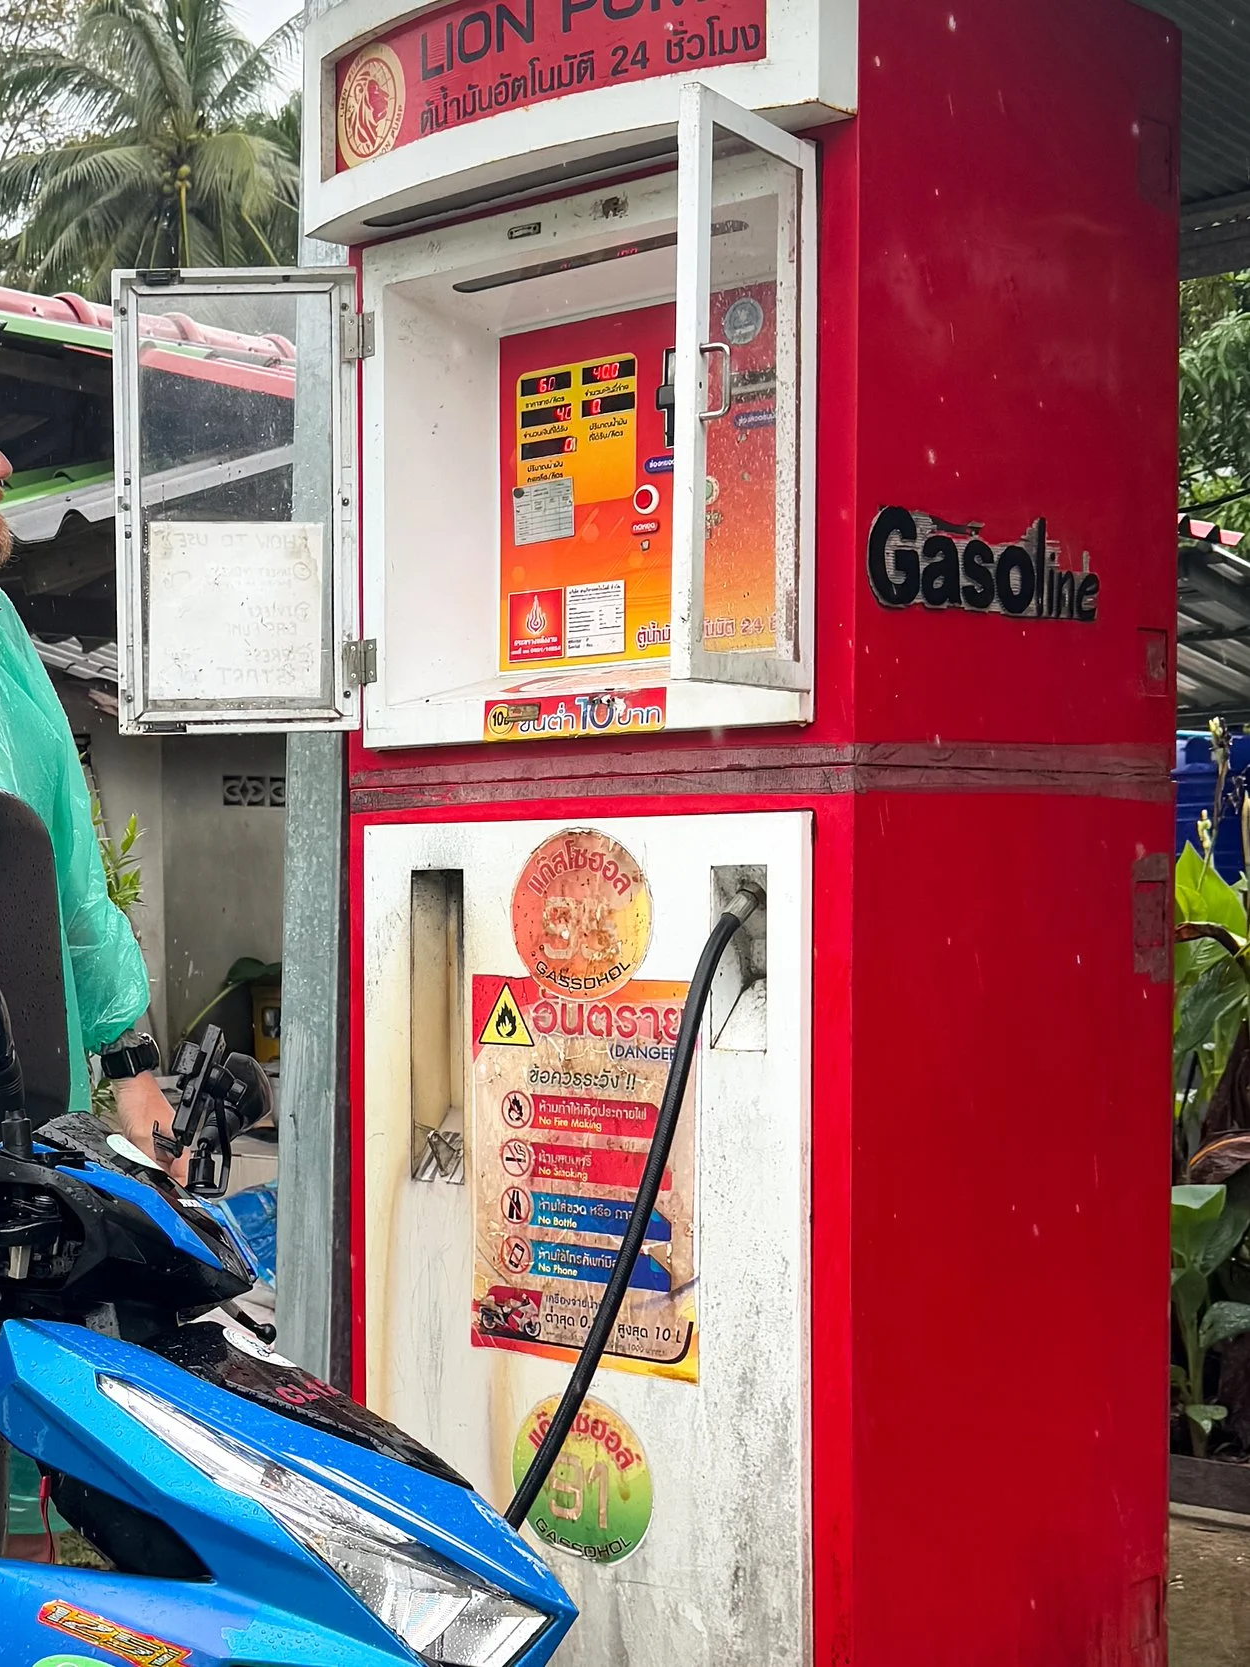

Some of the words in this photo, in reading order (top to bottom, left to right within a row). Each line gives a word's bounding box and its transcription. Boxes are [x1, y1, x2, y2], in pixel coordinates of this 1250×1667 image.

[420, 0, 536, 81] LION
[611, 44, 648, 78] 24
[666, 16, 760, 66] ชั่วโมง
[867, 505, 1099, 621] Gasoline
[535, 961, 631, 990] GASSOHOL
[531, 988, 683, 1042] อันตราย
[529, 1064, 619, 1091] ข้อควรระวัง
[626, 1072, 636, 1091] !!
[538, 1116, 552, 1126] No
[554, 1117, 569, 1127] Fire
[571, 1118, 602, 1132] Making
[538, 1166, 551, 1176] No
[553, 1167, 588, 1181] Smoking
[538, 1215, 551, 1225] No
[553, 1216, 578, 1229] Bottle
[538, 1263, 551, 1273] No
[553, 1264, 578, 1277] Phone
[545, 1306, 575, 1330] ต่ำสุด
[617, 1323, 648, 1341] สูงสุด
[655, 1326, 671, 1342] 10
[676, 1330, 682, 1343] L
[548, 1453, 609, 1529] 91
